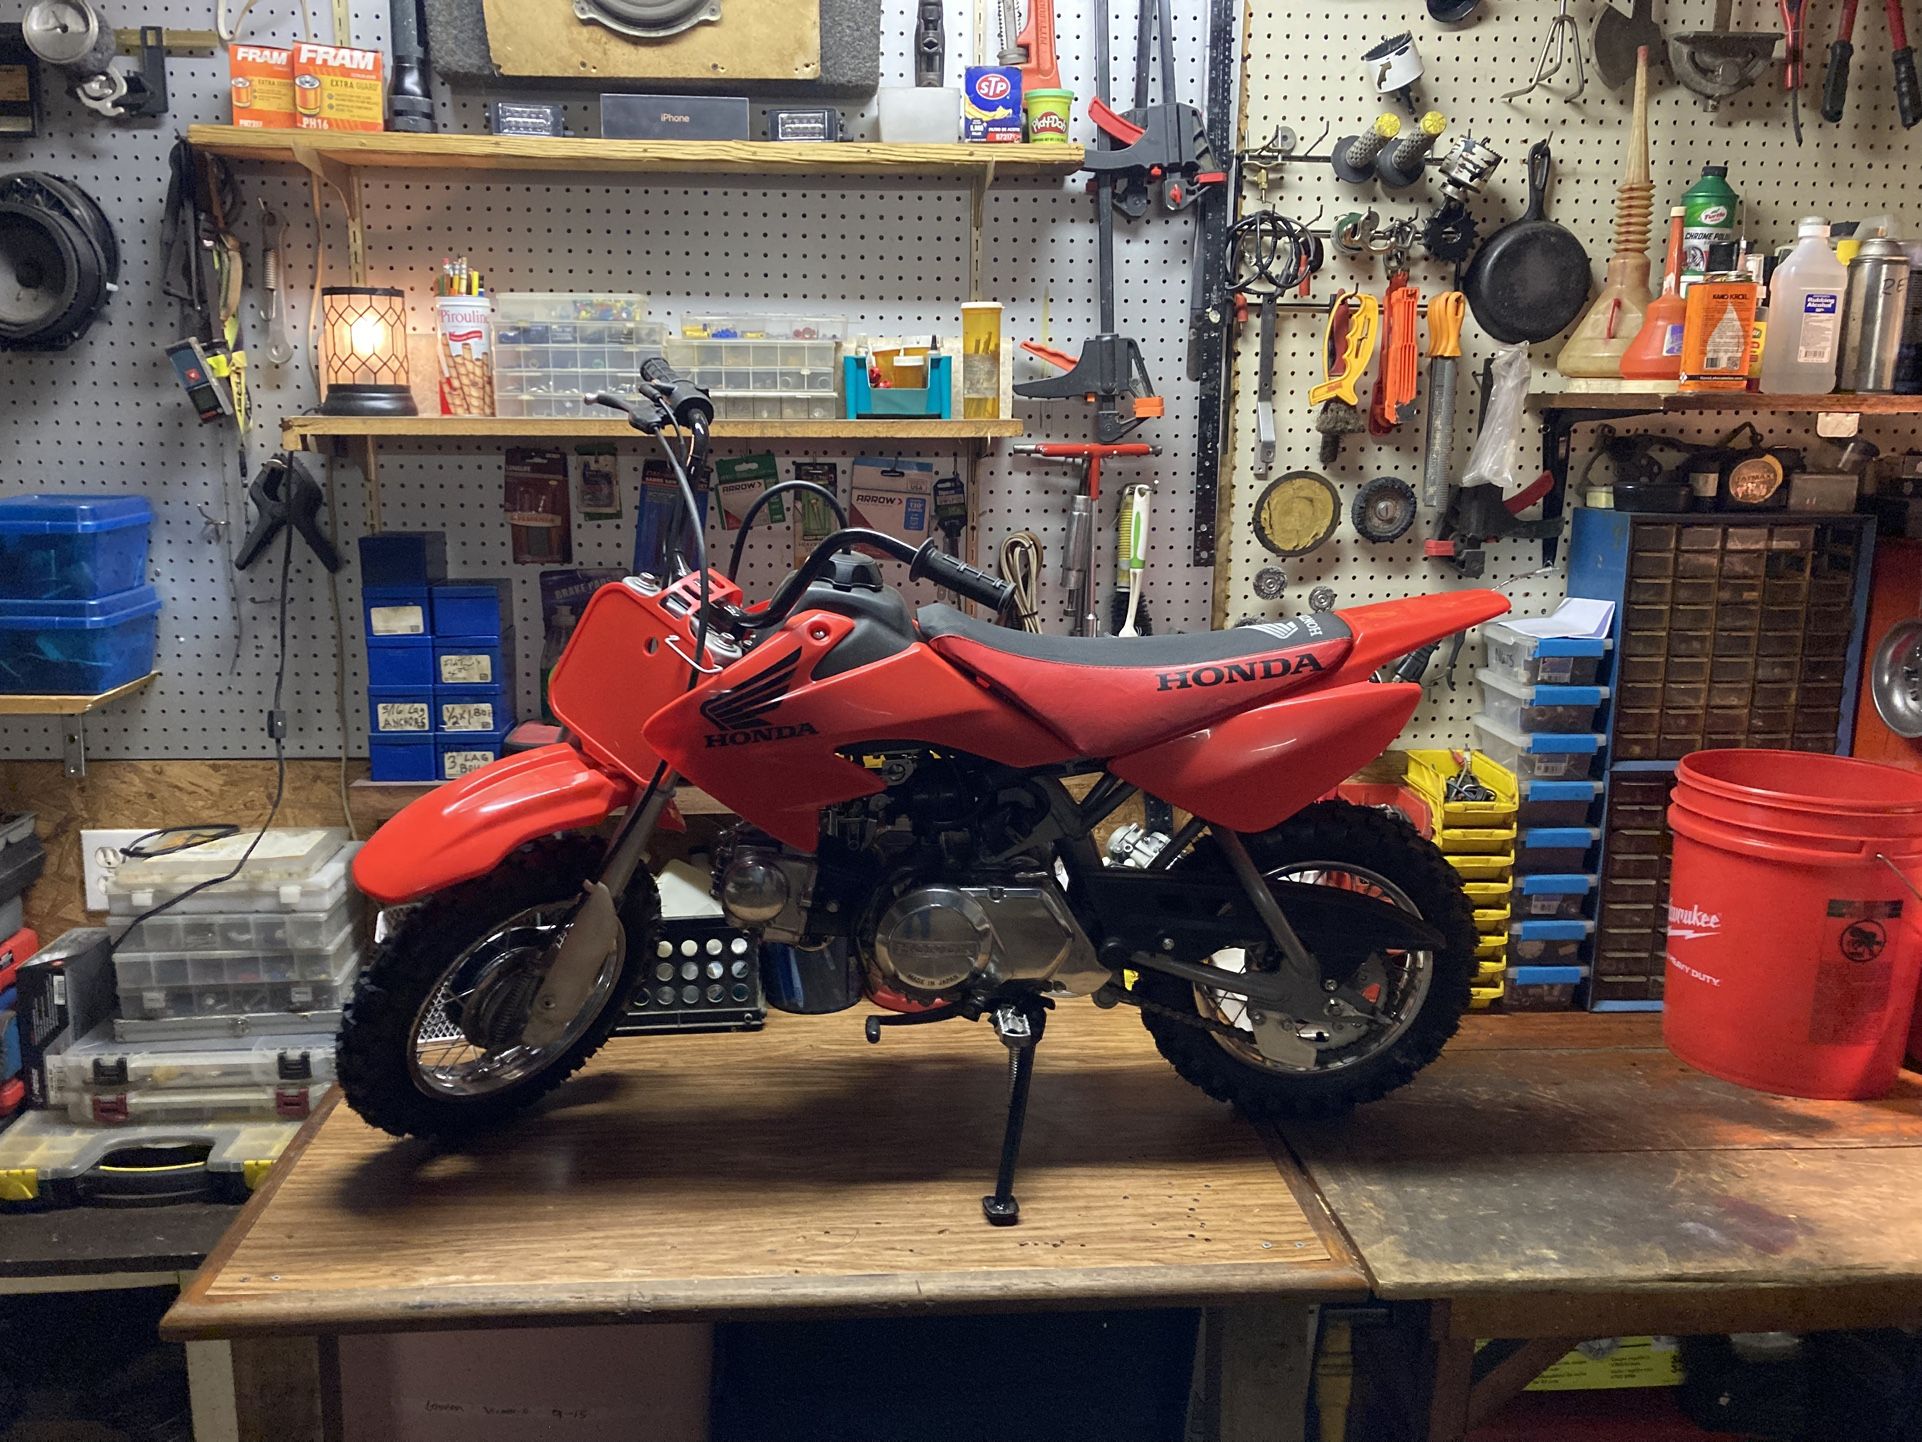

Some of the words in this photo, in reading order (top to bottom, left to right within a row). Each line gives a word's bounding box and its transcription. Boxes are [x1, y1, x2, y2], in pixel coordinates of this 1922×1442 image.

[236, 47, 288, 65] FRAM
[299, 43, 376, 71] FRAM
[330, 79, 354, 89] EXTRA
[980, 77, 1007, 97] STP
[302, 117, 329, 130] PH16
[660, 112, 690, 123] iPhone
[1704, 211, 1726, 220] Turtle
[1684, 232, 1713, 240] CHROME
[440, 309, 489, 324] Piroulin
[722, 482, 757, 494] ARROW
[856, 494, 896, 505] ARROW
[554, 585, 586, 600] BRAKE
[1156, 653, 1325, 692] HONDA
[704, 722, 819, 748] HONDA
